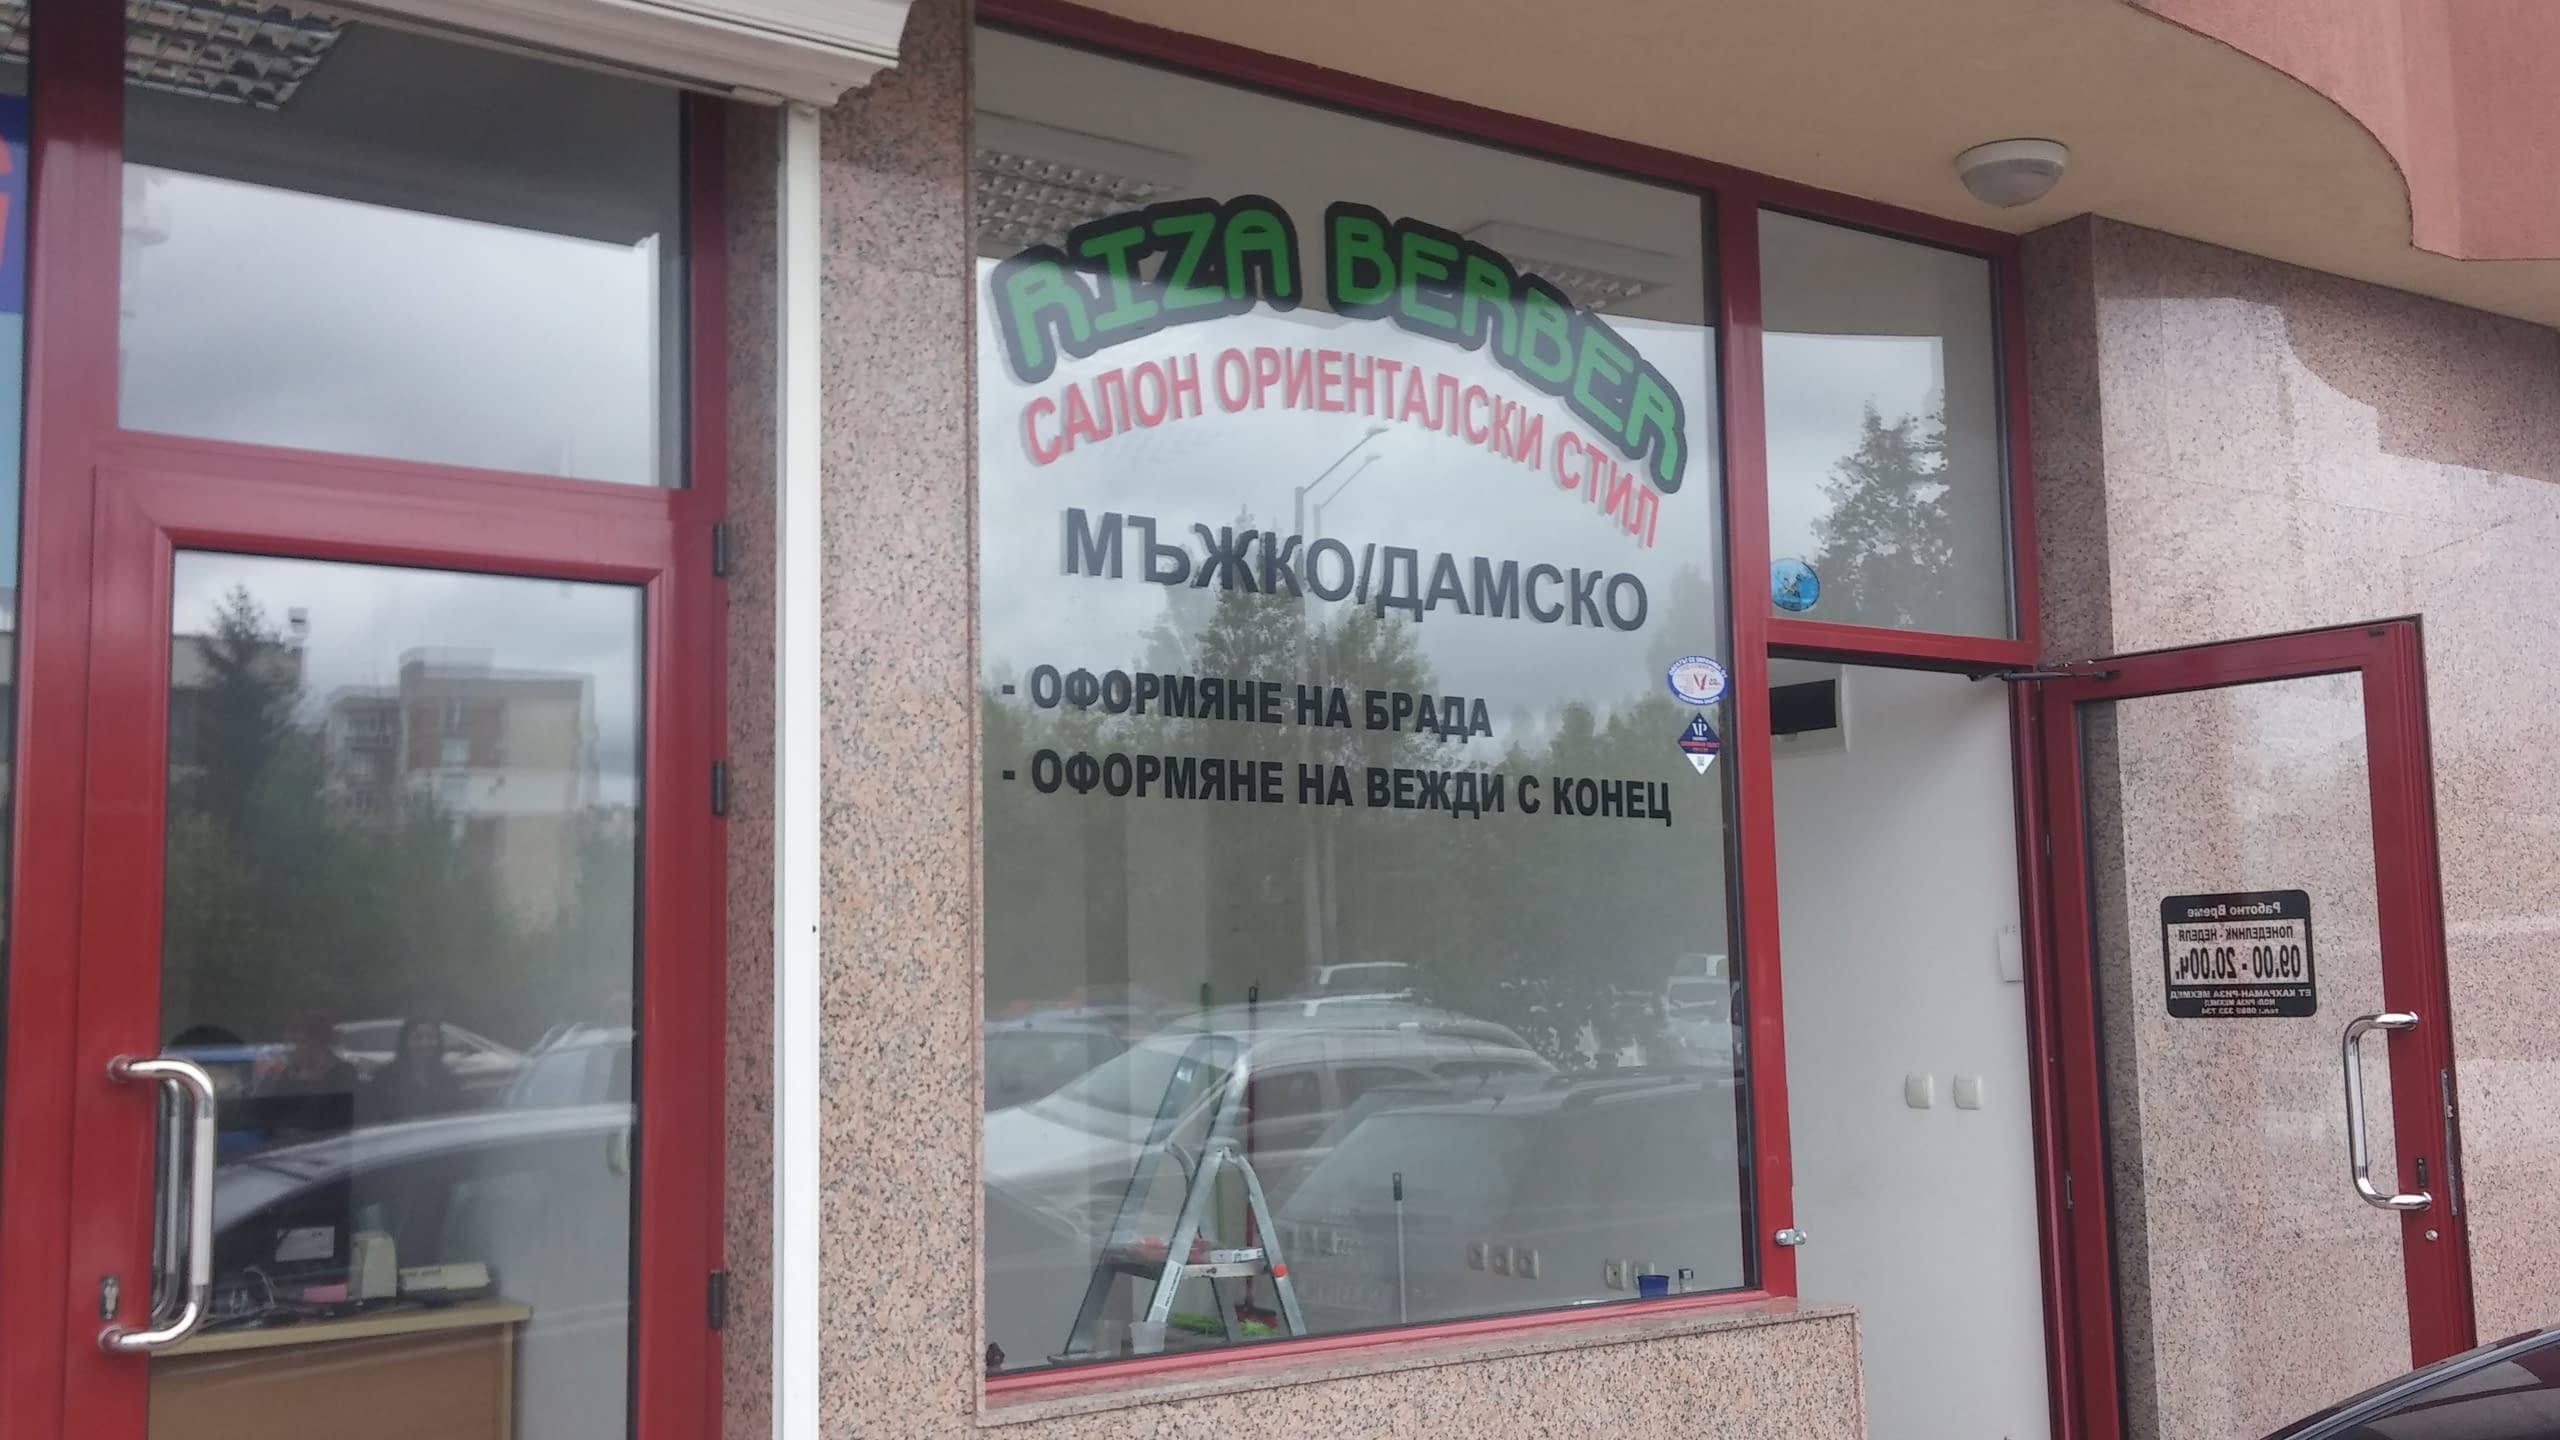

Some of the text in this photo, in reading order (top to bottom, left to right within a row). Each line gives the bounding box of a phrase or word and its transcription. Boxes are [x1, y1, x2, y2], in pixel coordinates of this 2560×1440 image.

[994, 197, 1685, 491] RIZA BERBER
[1024, 346, 1660, 548] САЛОН ОРИЕНТАЛСКИ СТИЛ
[1066, 507, 1648, 631] МЪЖКО/ДАМСКО
[1031, 664, 1282, 723] ОФОРМЯНЕ
[1298, 684, 1352, 728] НА
[1365, 690, 1493, 743] БРАДА
[1031, 749, 1284, 803] ОФОРМЯНЕ
[1299, 763, 1354, 807] НА
[1366, 767, 1504, 819] ВЕЖДИ
[1518, 775, 1540, 814] С
[1553, 777, 1672, 827] КОНЕЦ
